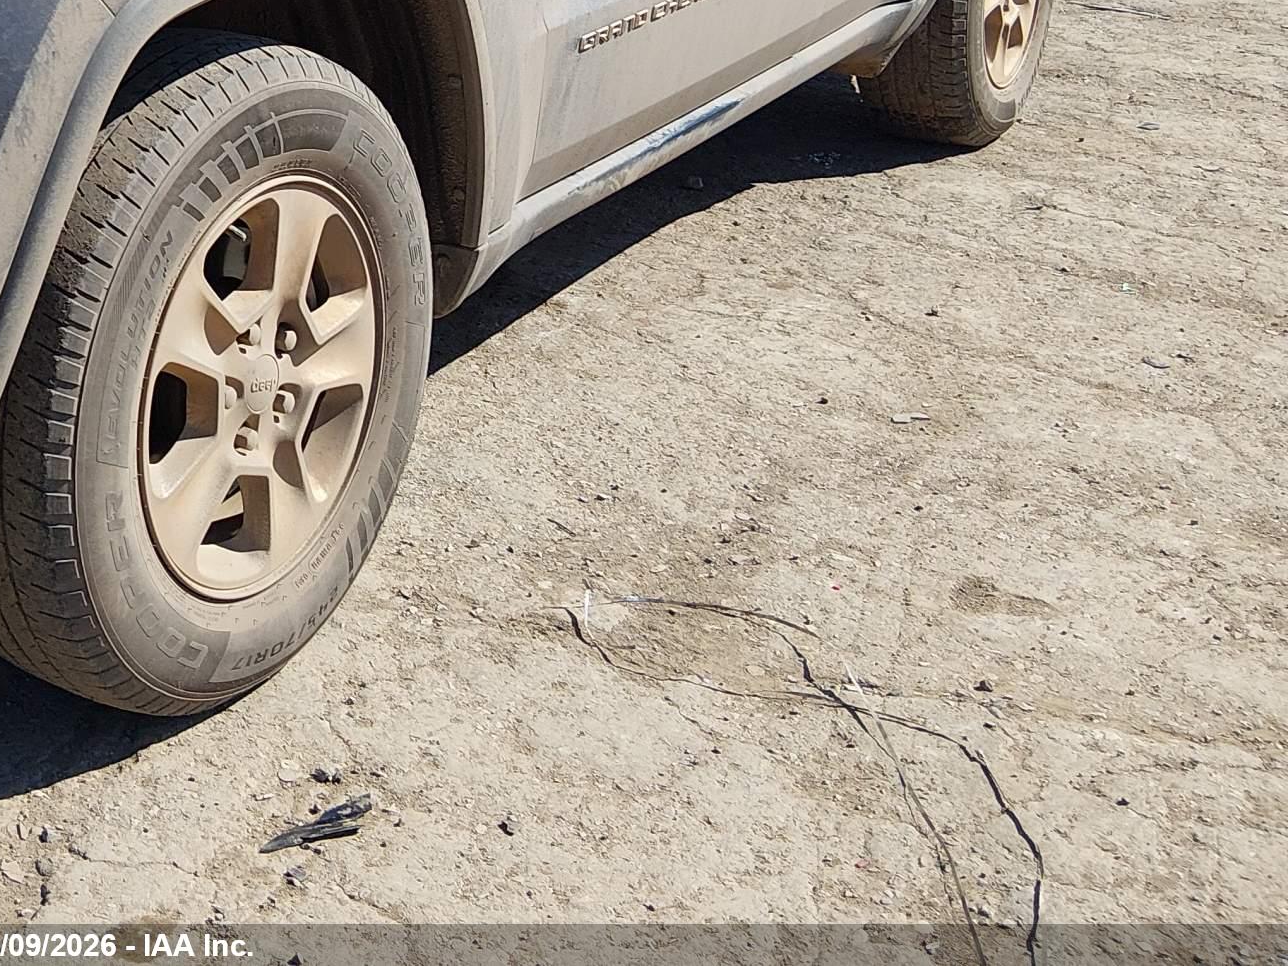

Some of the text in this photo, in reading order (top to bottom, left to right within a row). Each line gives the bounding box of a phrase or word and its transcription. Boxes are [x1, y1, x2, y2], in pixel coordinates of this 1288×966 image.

[577, 8, 649, 54] GRAND
[352, 128, 427, 307] COOPER
[104, 490, 210, 670] COOPER
[231, 585, 339, 671] 245/70R17
